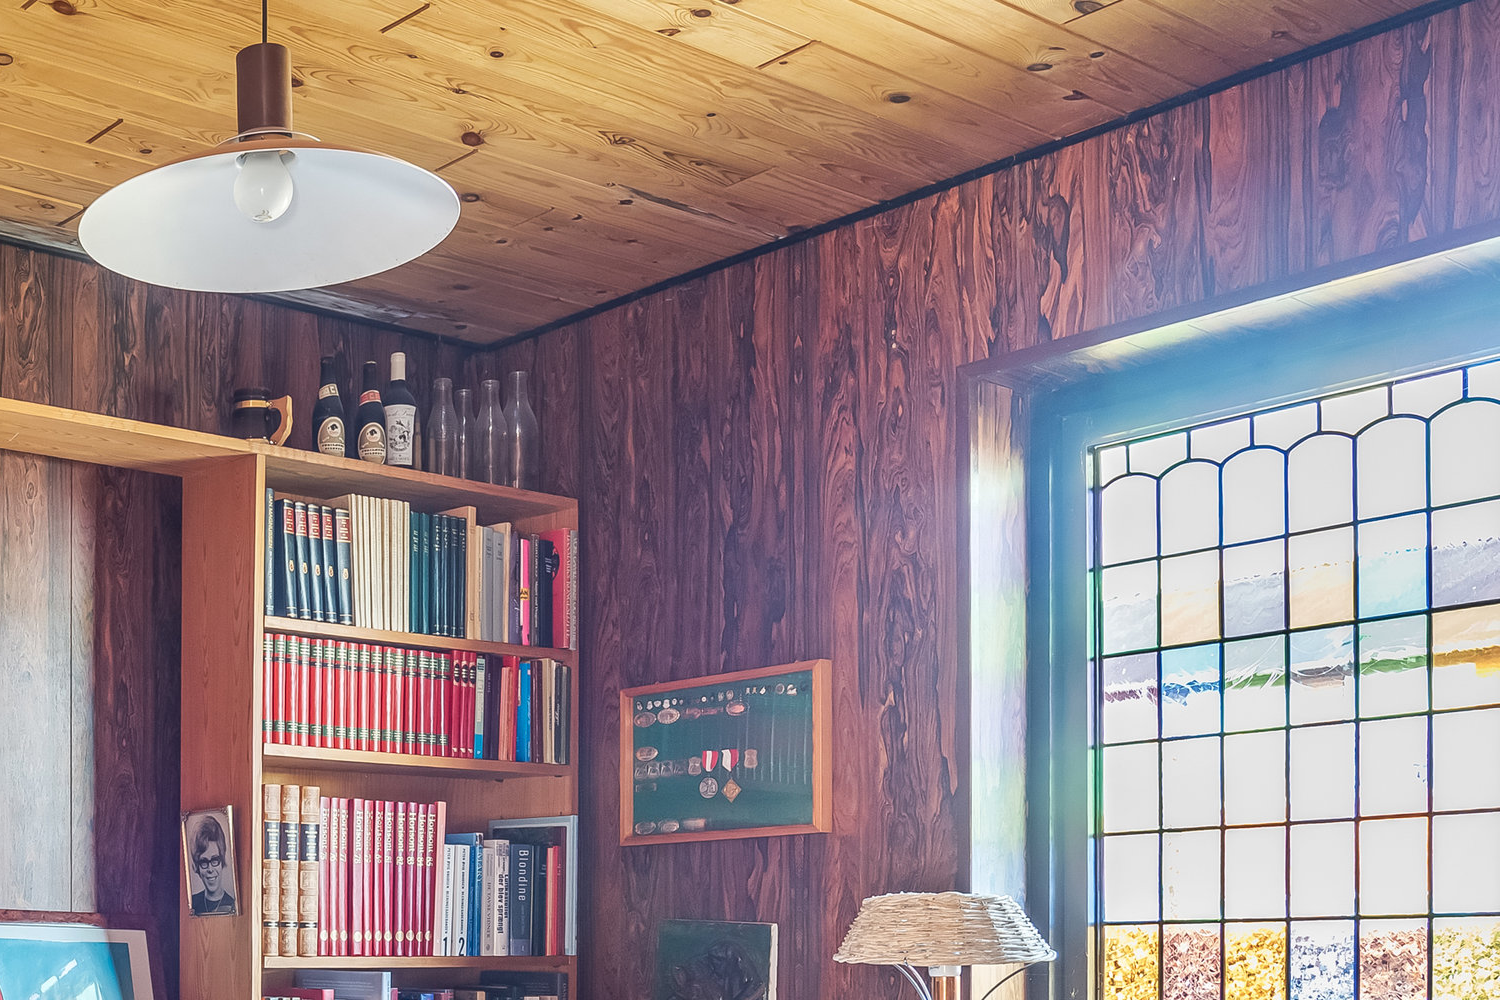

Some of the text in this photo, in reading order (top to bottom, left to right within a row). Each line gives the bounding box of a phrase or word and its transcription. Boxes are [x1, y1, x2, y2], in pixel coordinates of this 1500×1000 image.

[408, 812, 416, 852] Horisont
[428, 814, 436, 853] Horisont
[340, 853, 346, 862] 77
[396, 856, 402, 865] 82
[518, 850, 529, 901] Blondine
[443, 936, 448, 956] 1
[458, 937, 465, 956] 2
